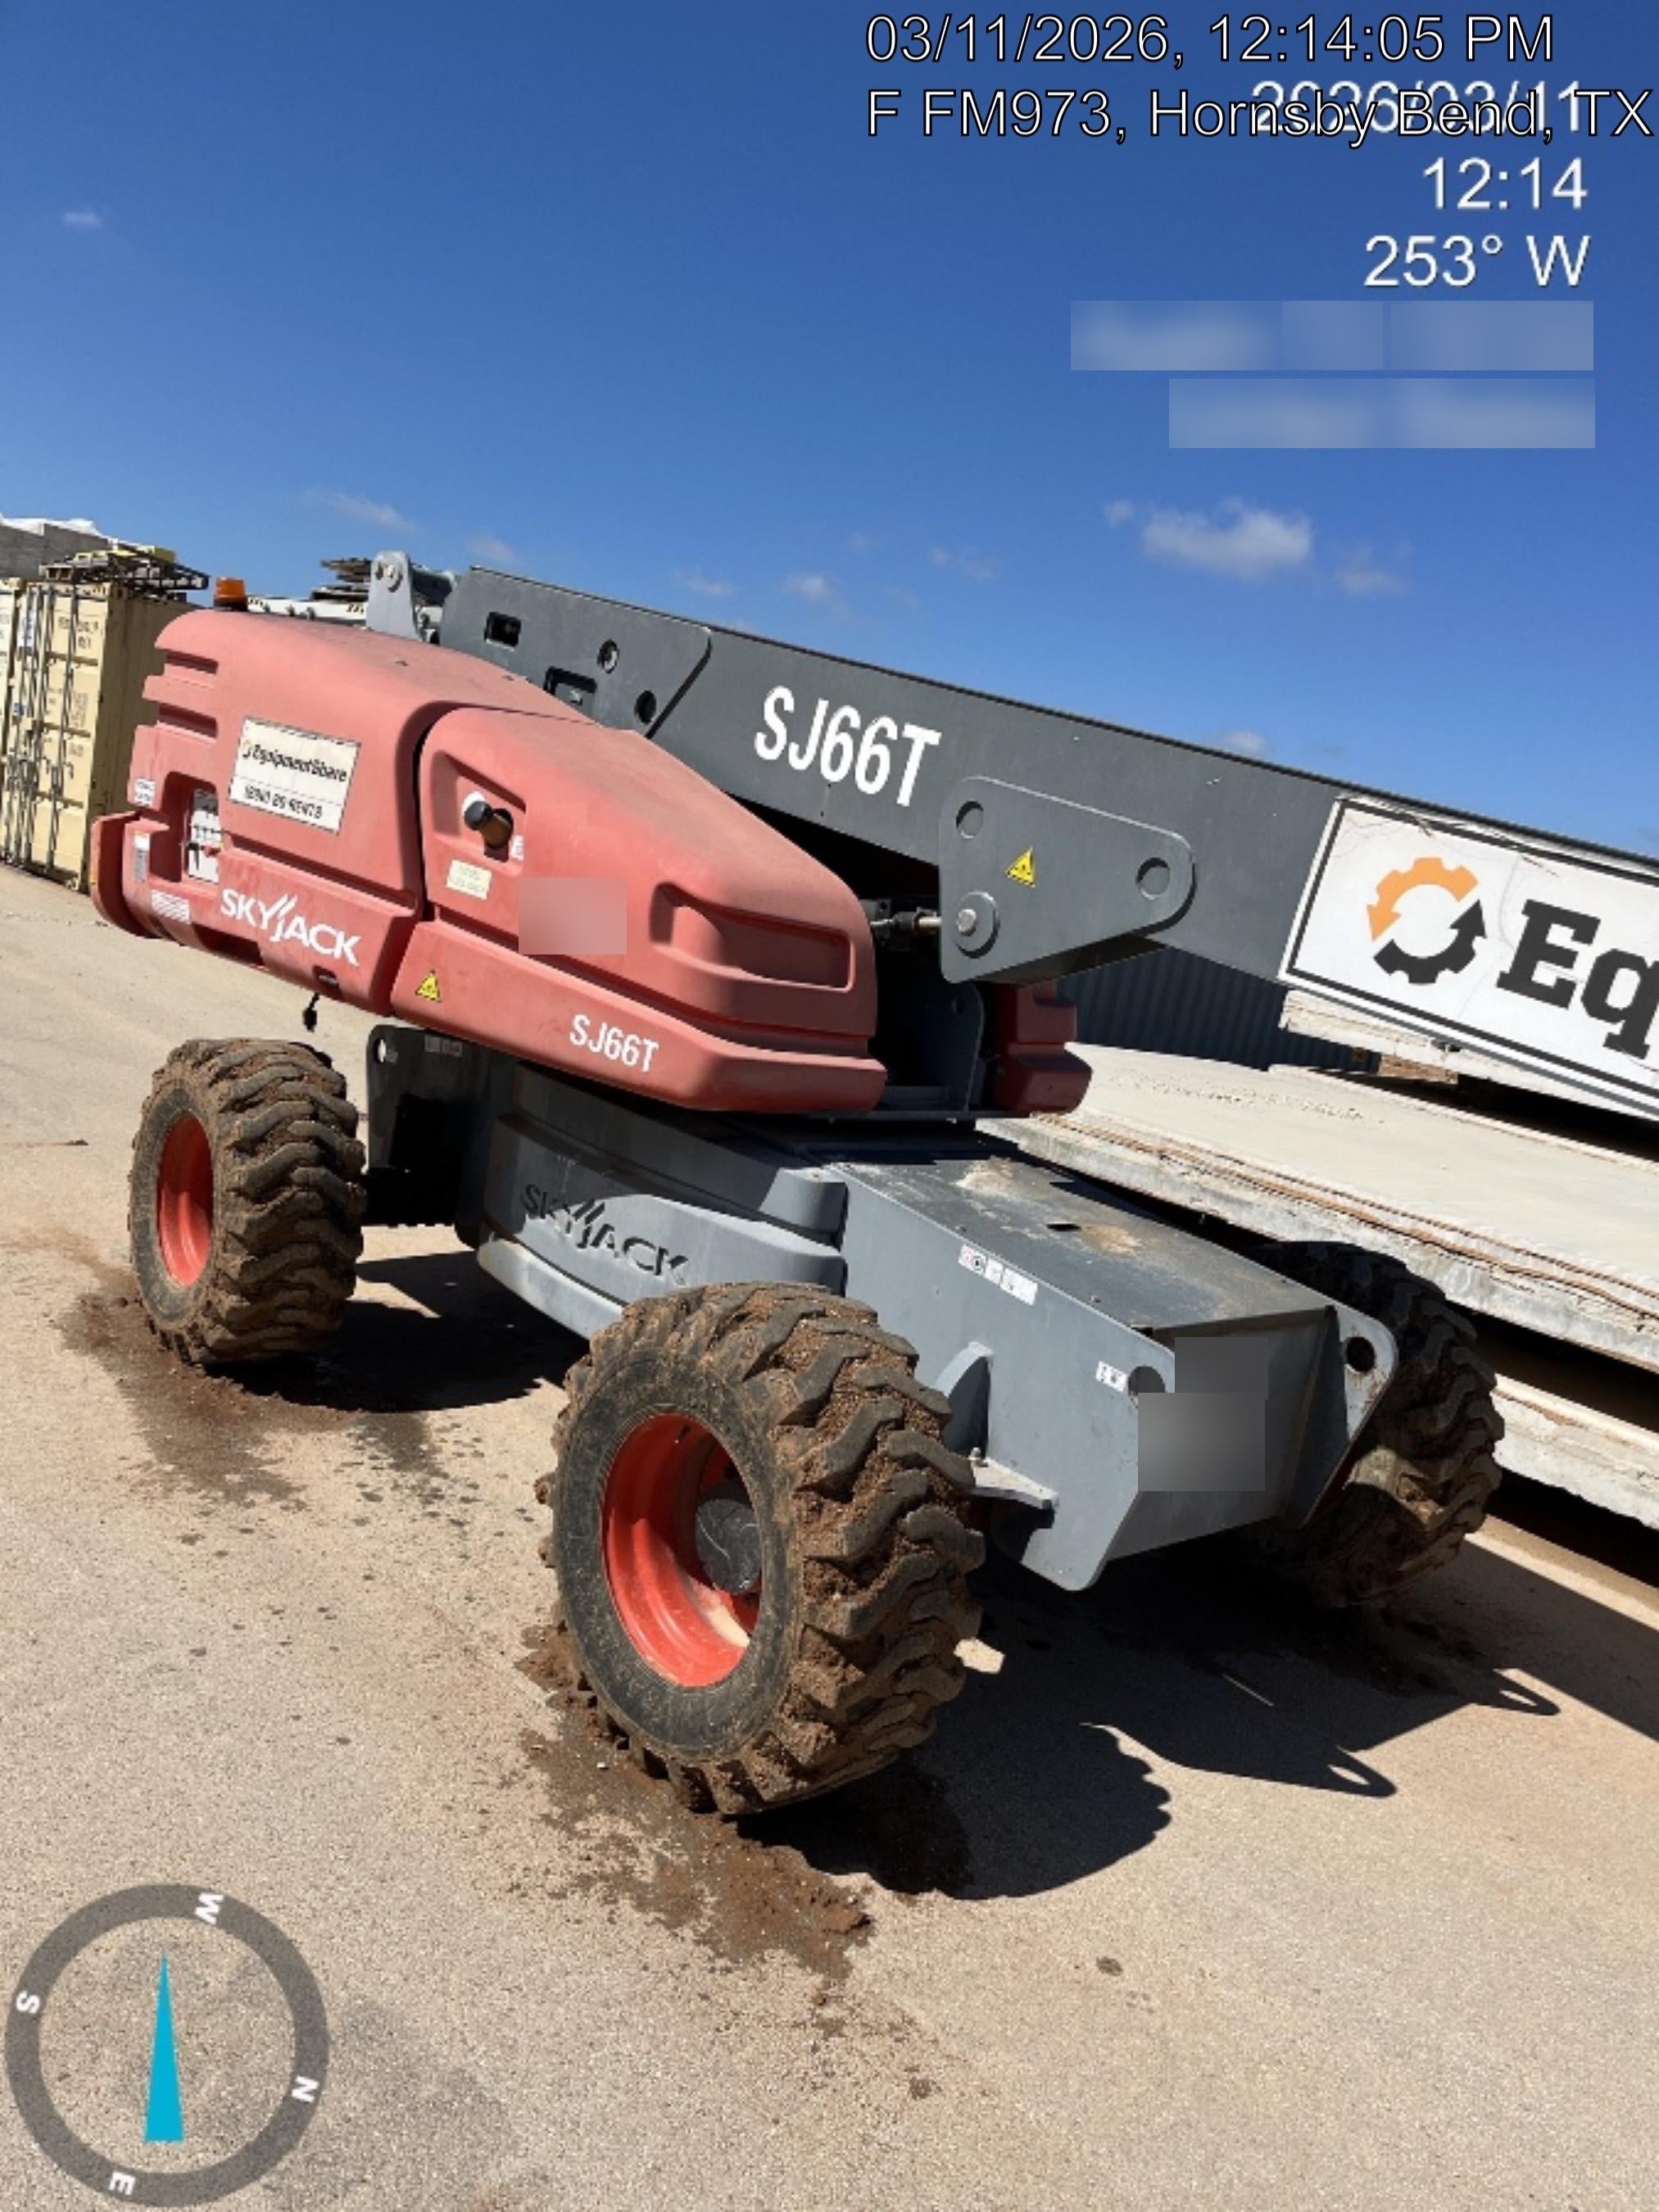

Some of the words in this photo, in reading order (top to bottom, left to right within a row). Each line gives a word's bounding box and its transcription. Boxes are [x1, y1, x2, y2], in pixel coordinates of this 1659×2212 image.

[755, 686, 941, 806] SJ66T
[220, 889, 362, 967] SKYJACK
[1496, 899, 1659, 1059] Eq
[569, 1013, 660, 1073] SJ66T
[523, 1184, 688, 1287] SKYJACK
